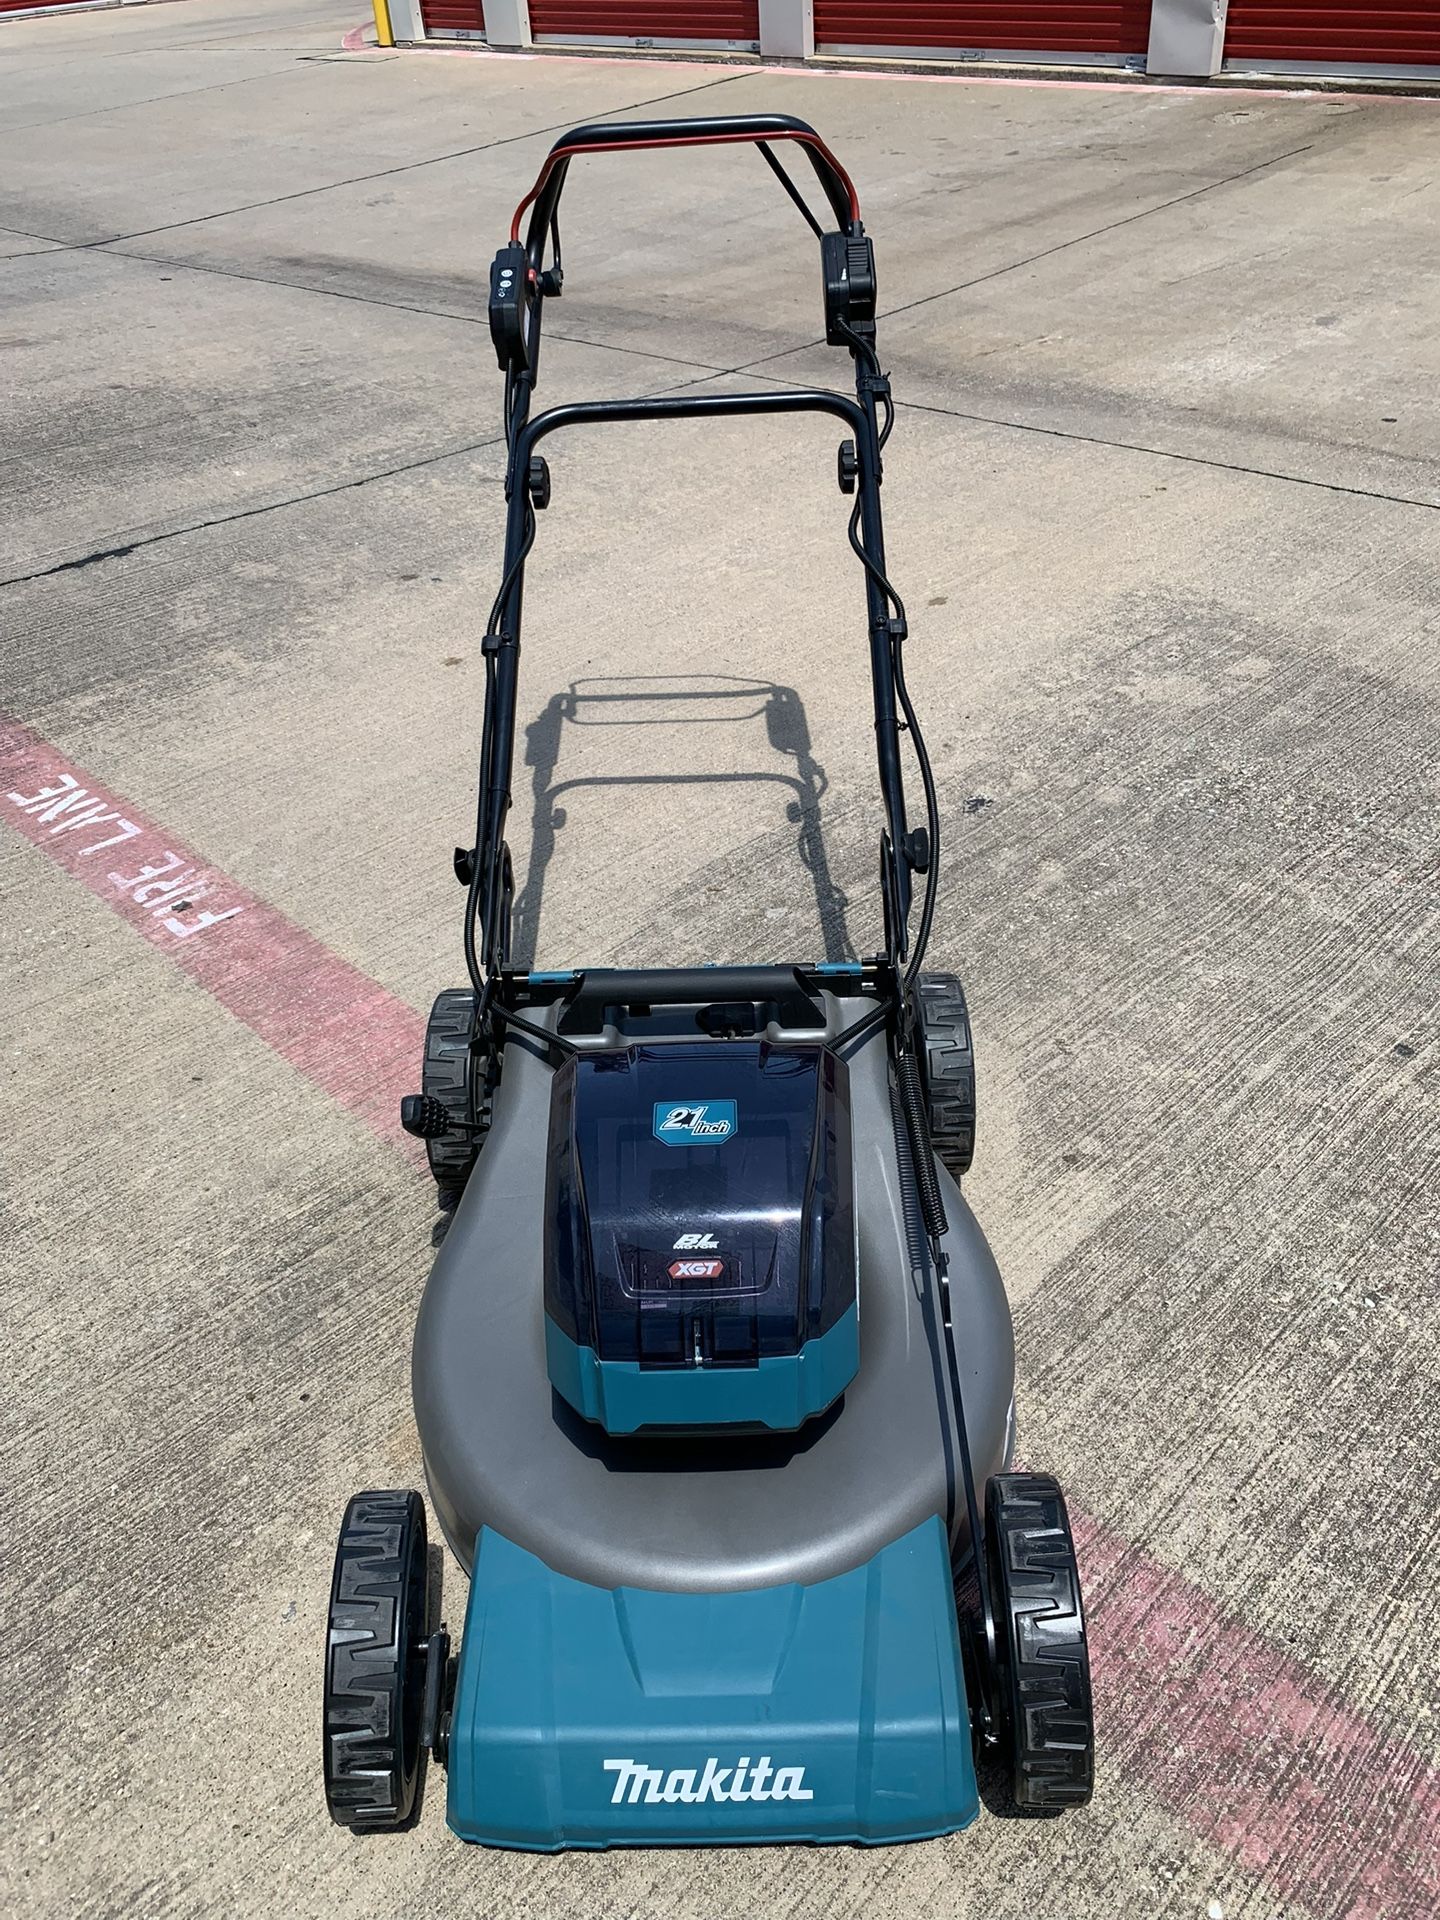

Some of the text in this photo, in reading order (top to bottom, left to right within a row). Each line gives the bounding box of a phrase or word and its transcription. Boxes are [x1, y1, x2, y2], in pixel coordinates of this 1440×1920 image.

[6, 773, 245, 937] FIRE LANE
[674, 1233, 719, 1245] BL
[675, 1262, 718, 1276] XGT
[603, 1756, 814, 1804] Makita
